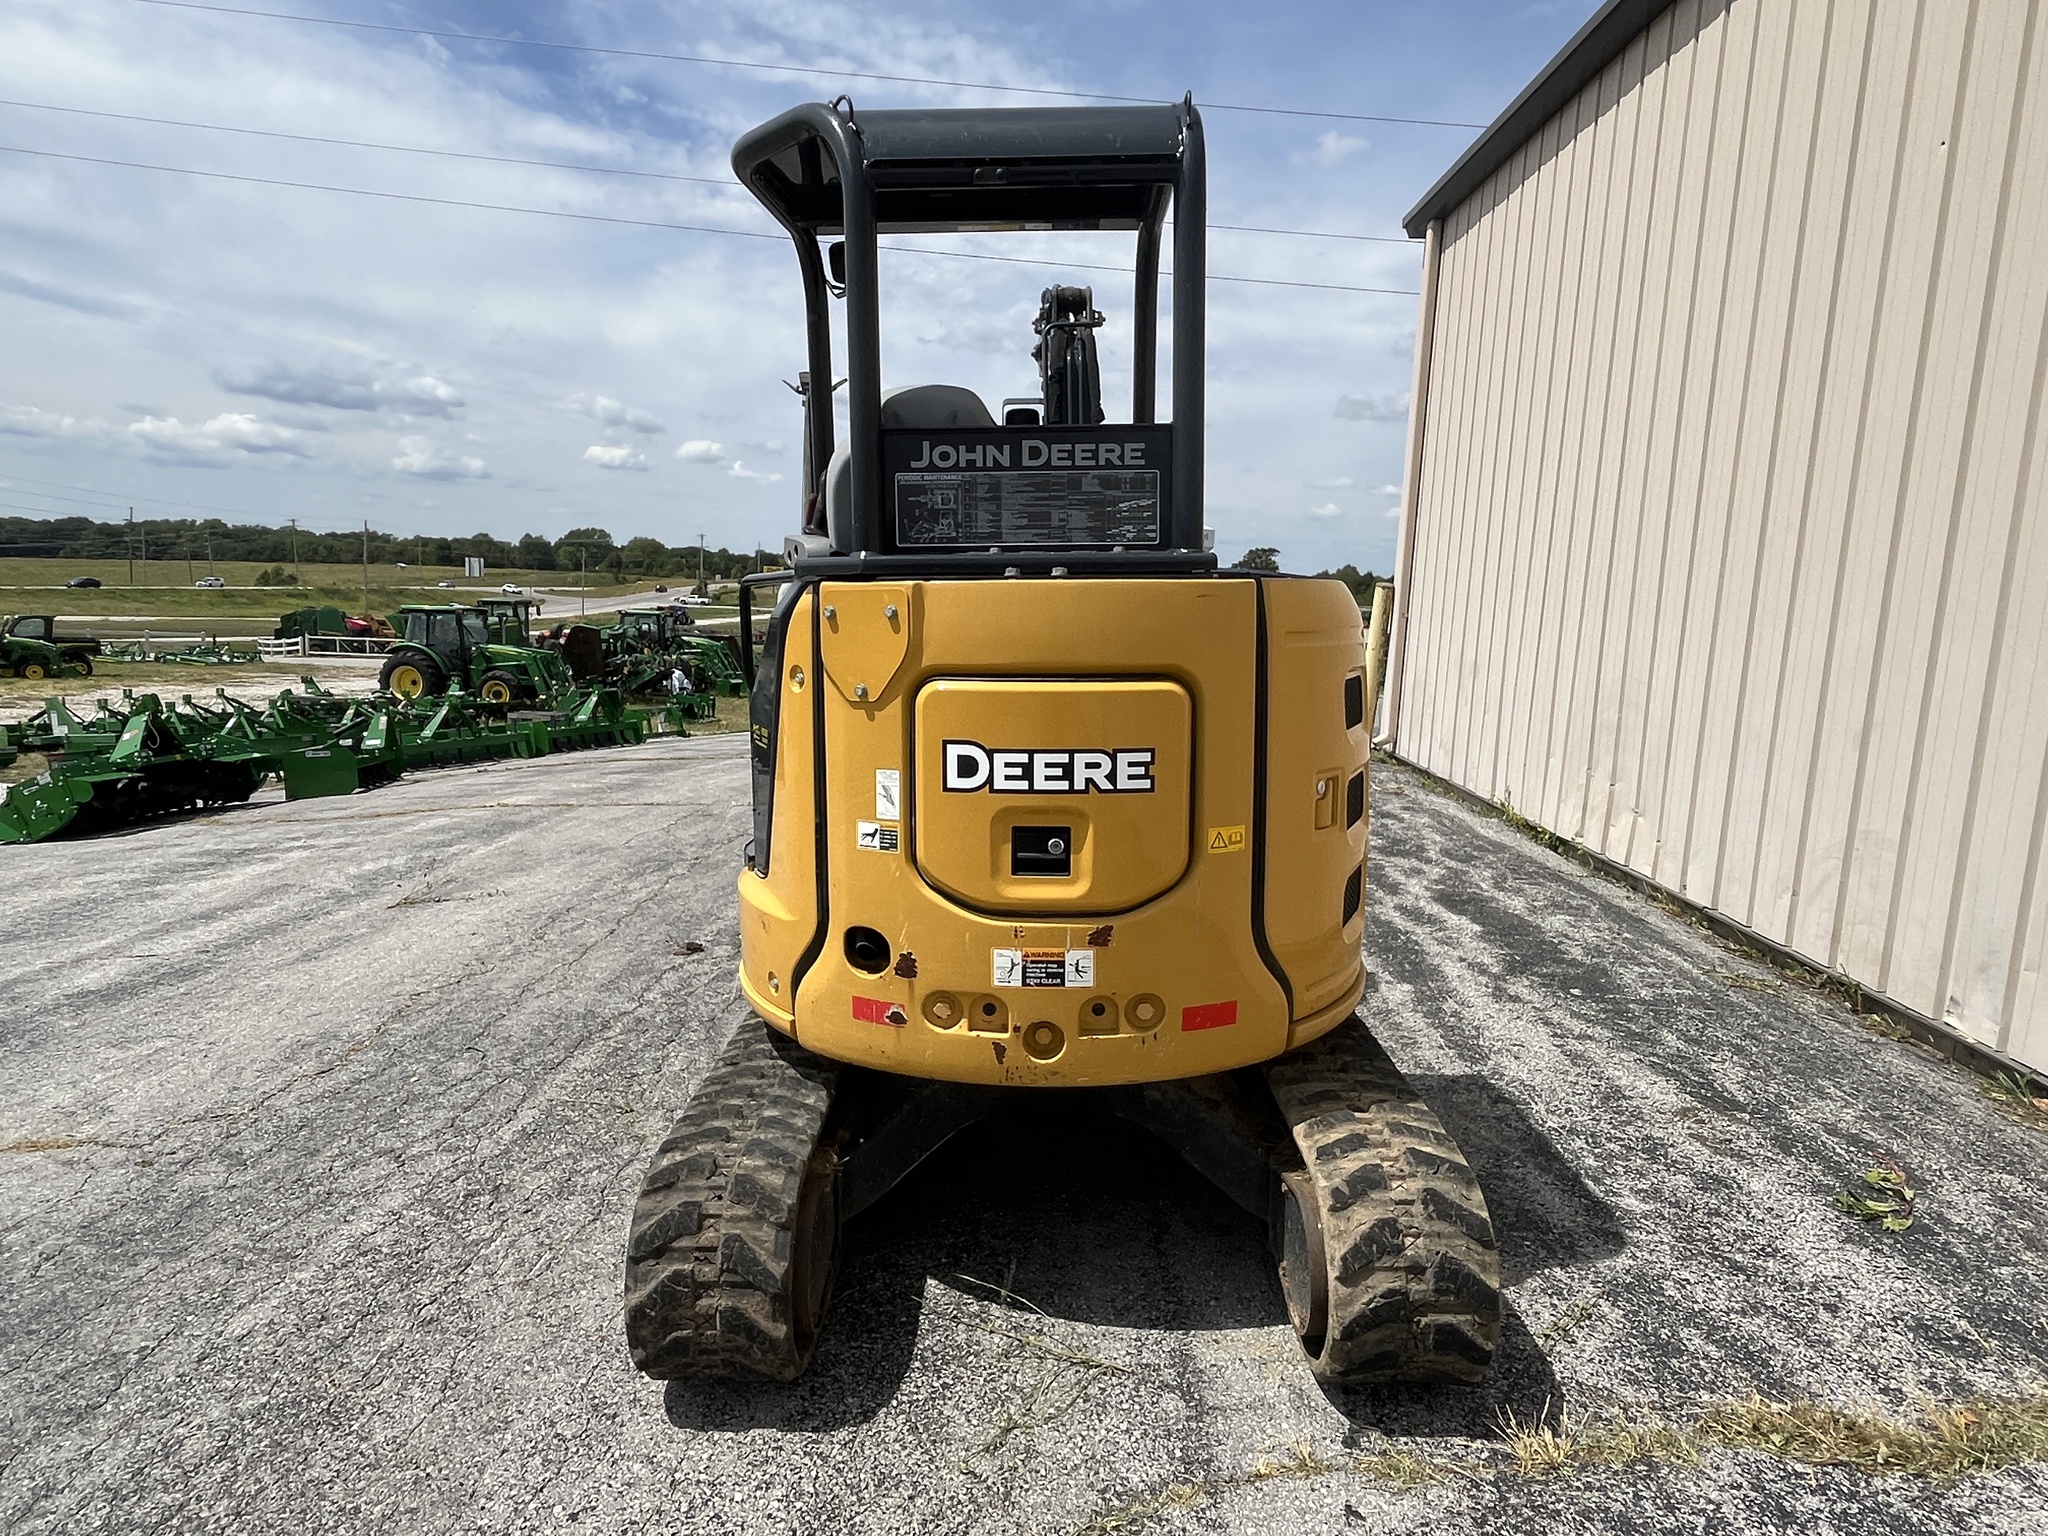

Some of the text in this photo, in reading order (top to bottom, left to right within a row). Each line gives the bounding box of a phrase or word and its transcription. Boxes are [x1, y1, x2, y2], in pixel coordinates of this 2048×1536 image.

[910, 439, 1146, 469] JOHN DEERE
[944, 742, 1154, 792] DEERE
